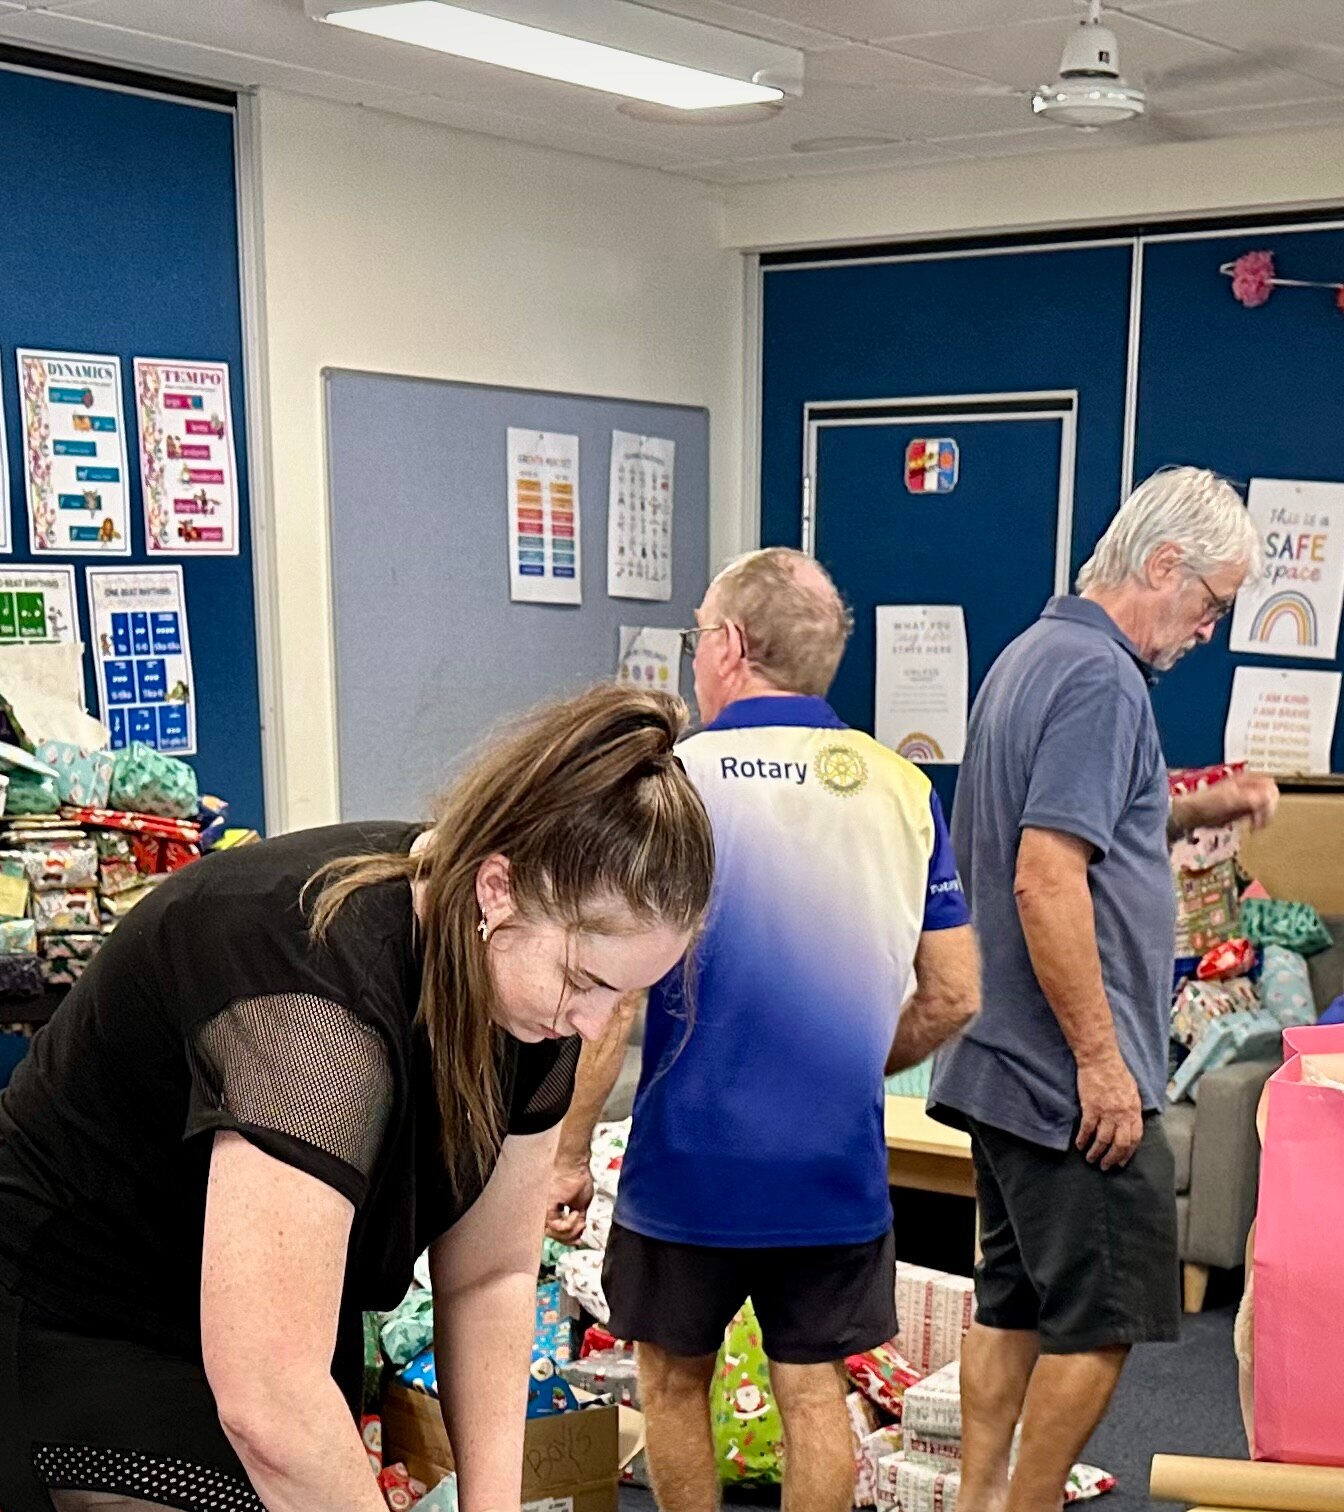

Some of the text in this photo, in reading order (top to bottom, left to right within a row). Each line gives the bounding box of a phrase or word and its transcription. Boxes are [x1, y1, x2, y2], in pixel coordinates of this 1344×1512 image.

[48, 362, 113, 379] DYNAMICS
[160, 369, 221, 386] TEMPO
[1264, 532, 1327, 561] SAFE
[1264, 563, 1321, 585] space
[720, 756, 807, 785] Rotary
